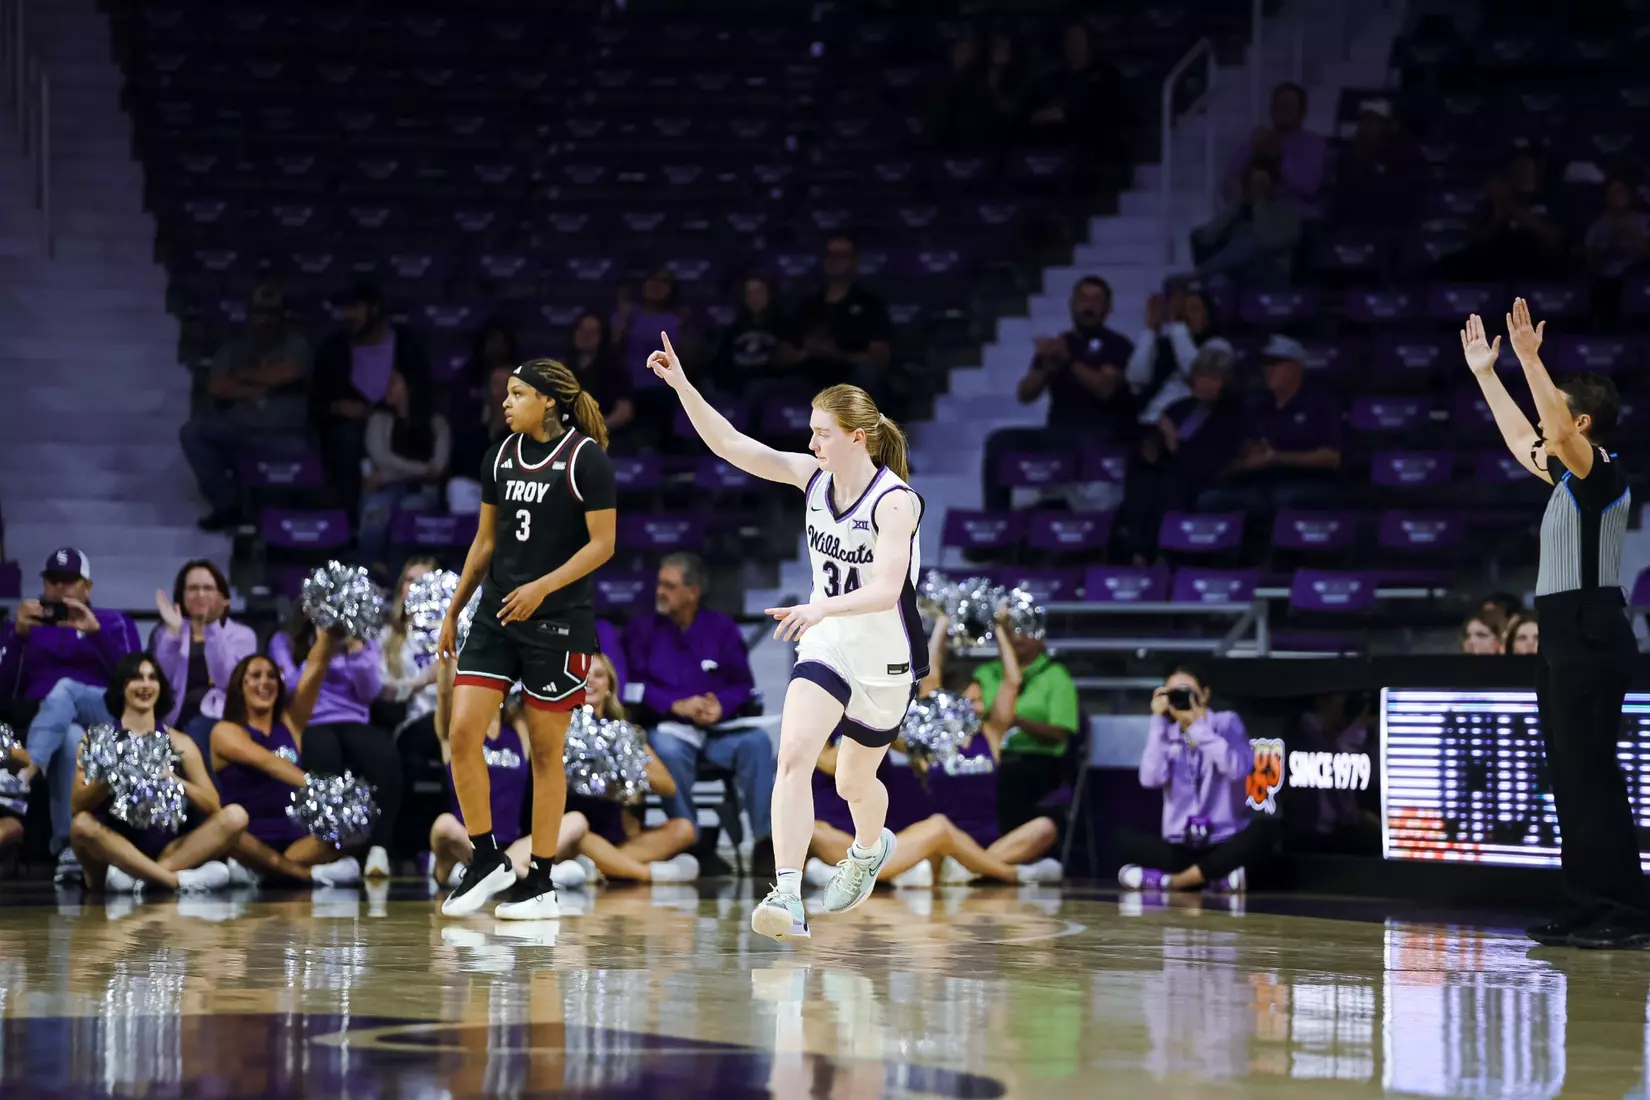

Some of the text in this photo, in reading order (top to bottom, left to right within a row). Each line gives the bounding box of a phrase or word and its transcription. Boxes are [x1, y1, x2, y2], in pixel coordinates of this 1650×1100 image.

[505, 480, 550, 503] TROY
[515, 509, 531, 541] 3
[808, 524, 874, 564] Wildcats
[823, 560, 862, 598] 34
[1289, 751, 1333, 789] SINCE
[1333, 752, 1371, 790] 1979
